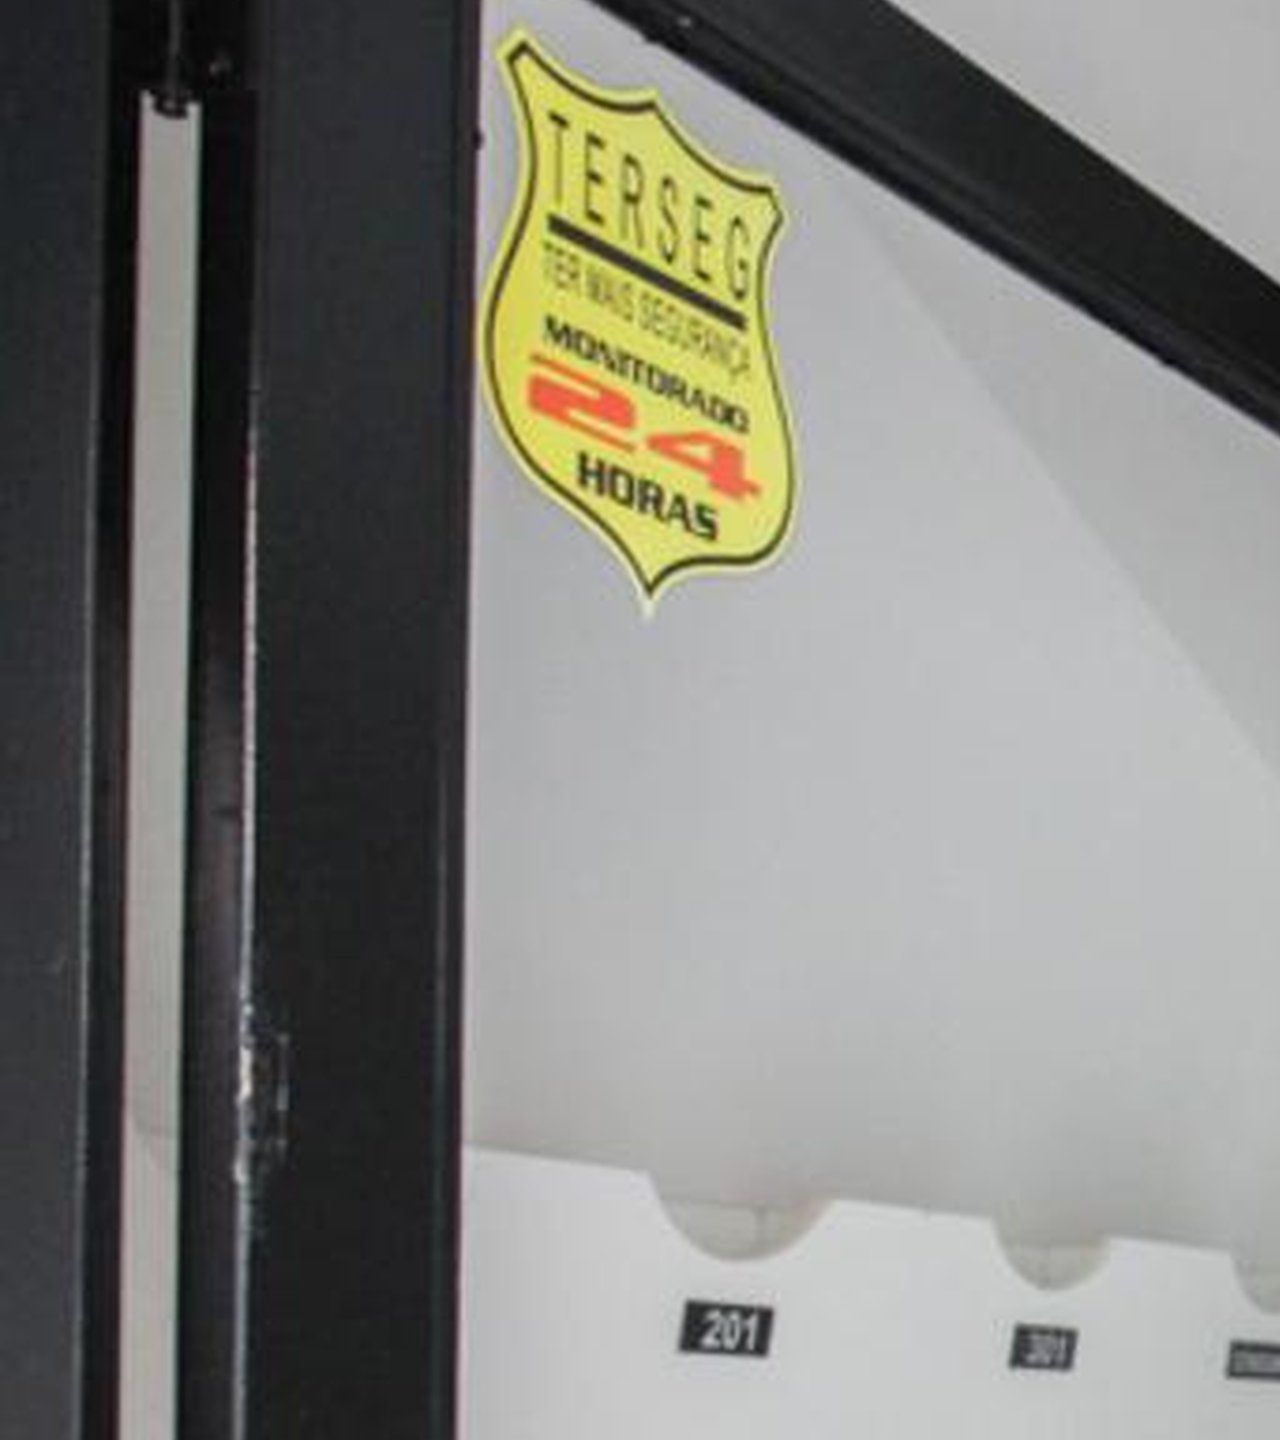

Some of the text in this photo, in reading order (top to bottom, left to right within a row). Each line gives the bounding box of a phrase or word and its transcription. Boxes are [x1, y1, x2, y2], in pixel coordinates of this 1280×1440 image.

[547, 112, 750, 301] TERSEG
[527, 353, 762, 500] 24
[545, 314, 749, 434] MONITORADO
[577, 450, 718, 542] HORAS
[701, 1309, 758, 1351] 201
